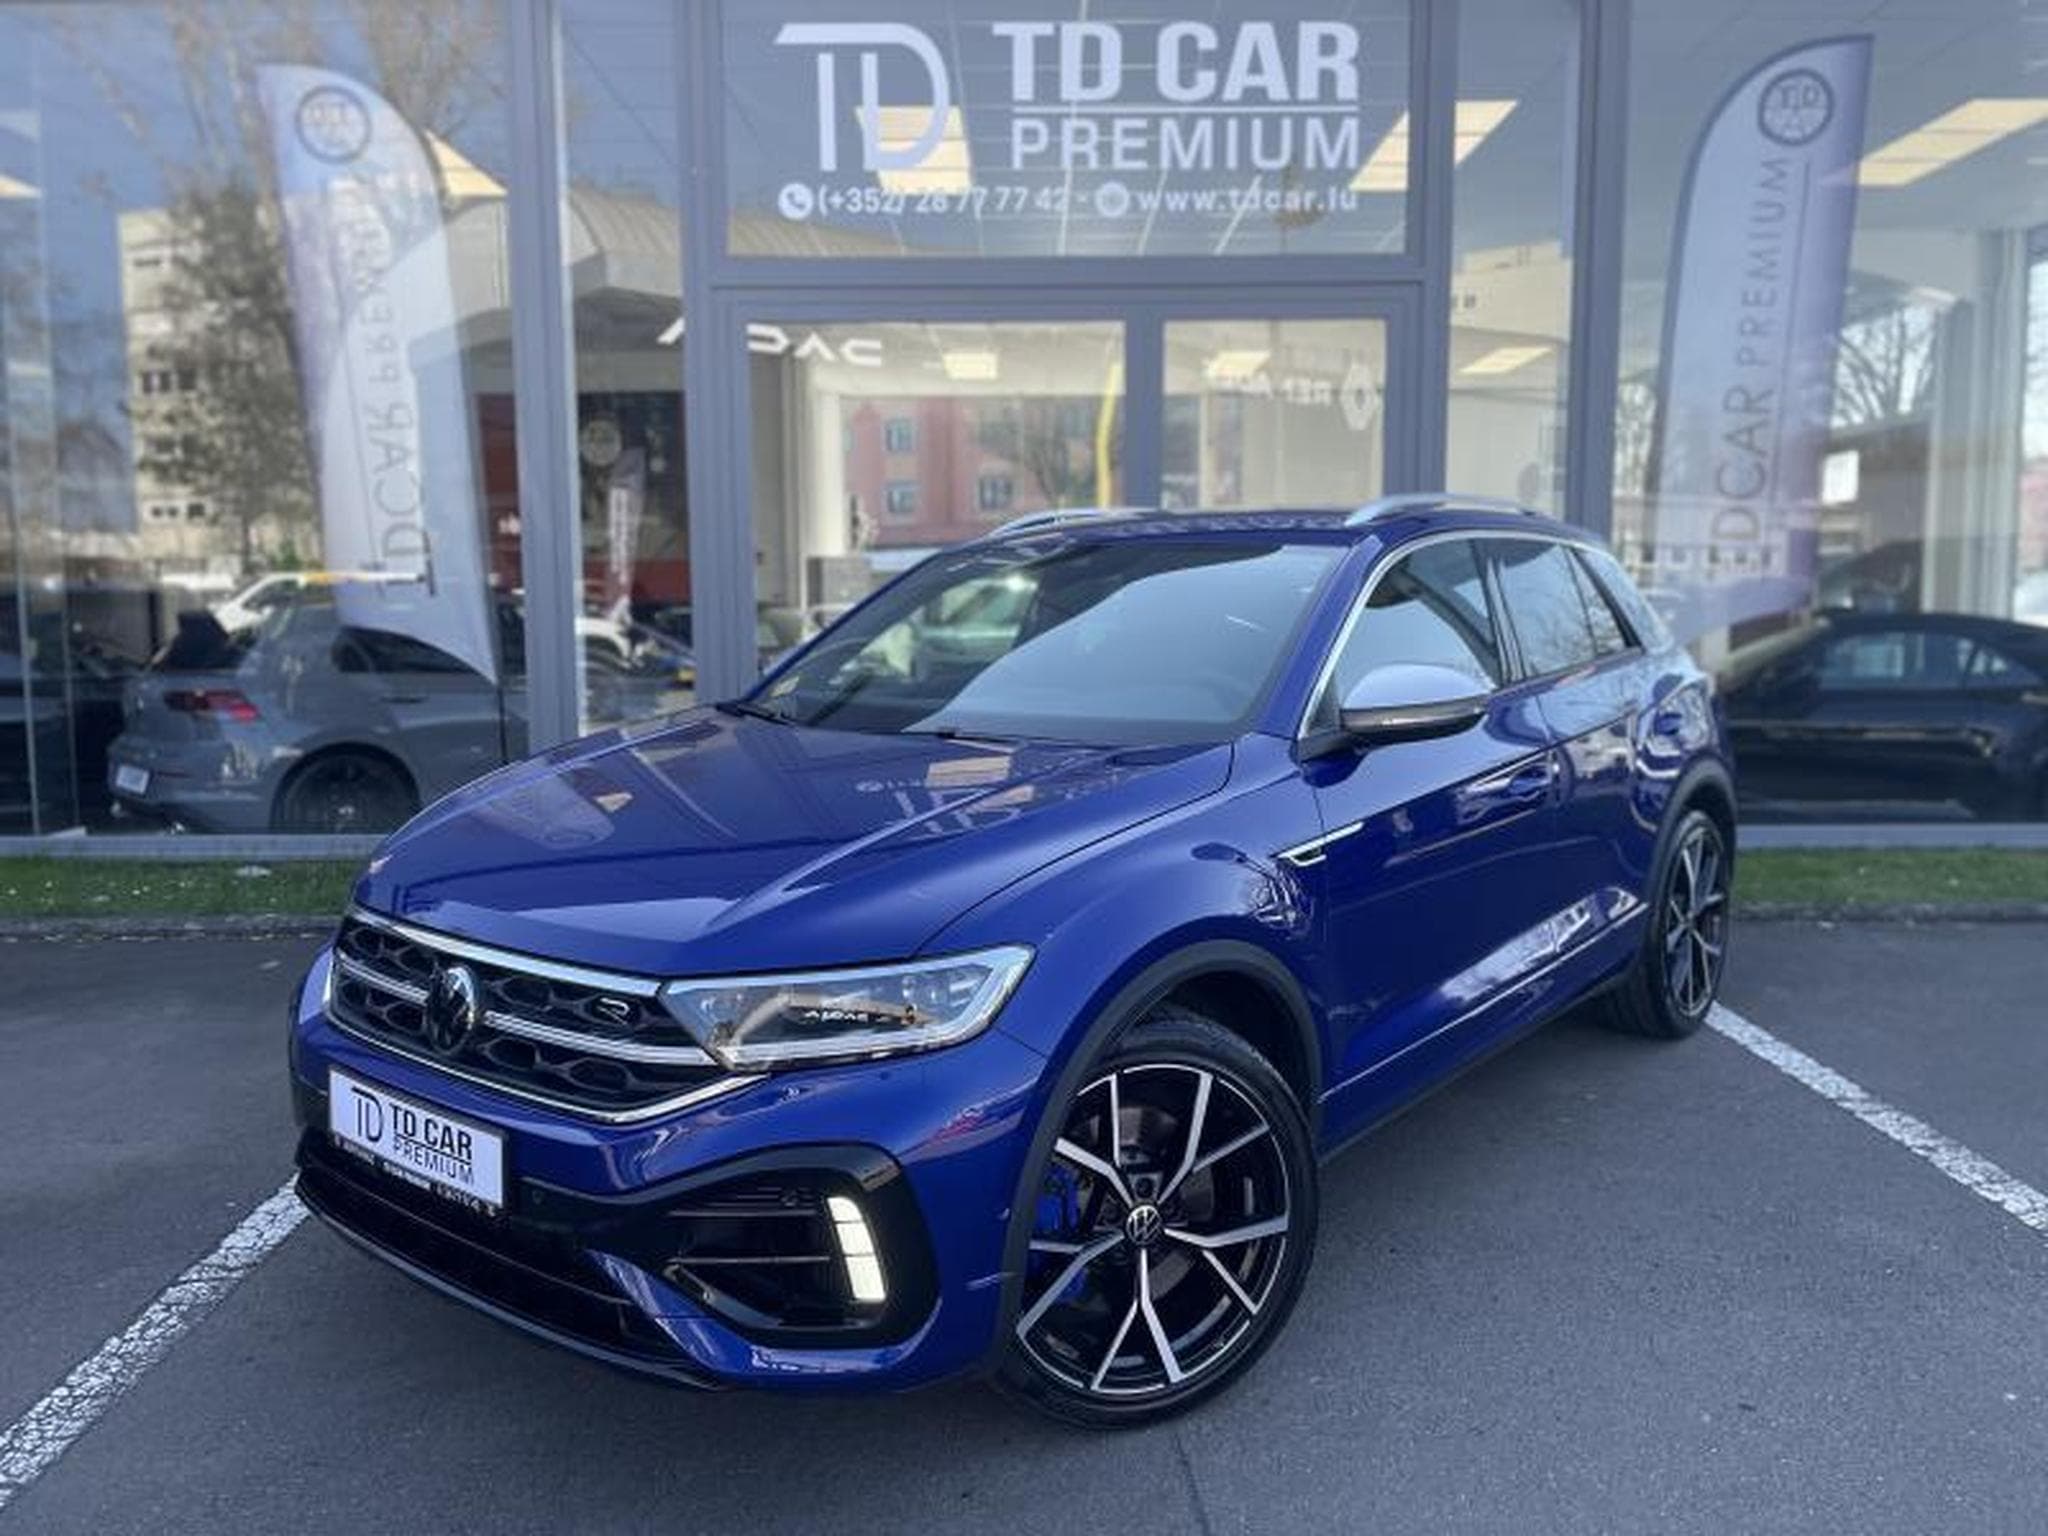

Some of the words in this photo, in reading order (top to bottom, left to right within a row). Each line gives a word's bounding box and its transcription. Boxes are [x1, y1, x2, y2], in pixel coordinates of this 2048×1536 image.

[992, 20, 1122, 102] TD
[1156, 20, 1360, 102] CAR
[1012, 117, 1360, 171] PREMIUM
[995, 186, 1029, 211] 77
[1736, 155, 1792, 369] PREMIUM
[389, 1103, 416, 1138] TD
[424, 1118, 472, 1161] CAR
[393, 1131, 475, 1187] PREMIUM
